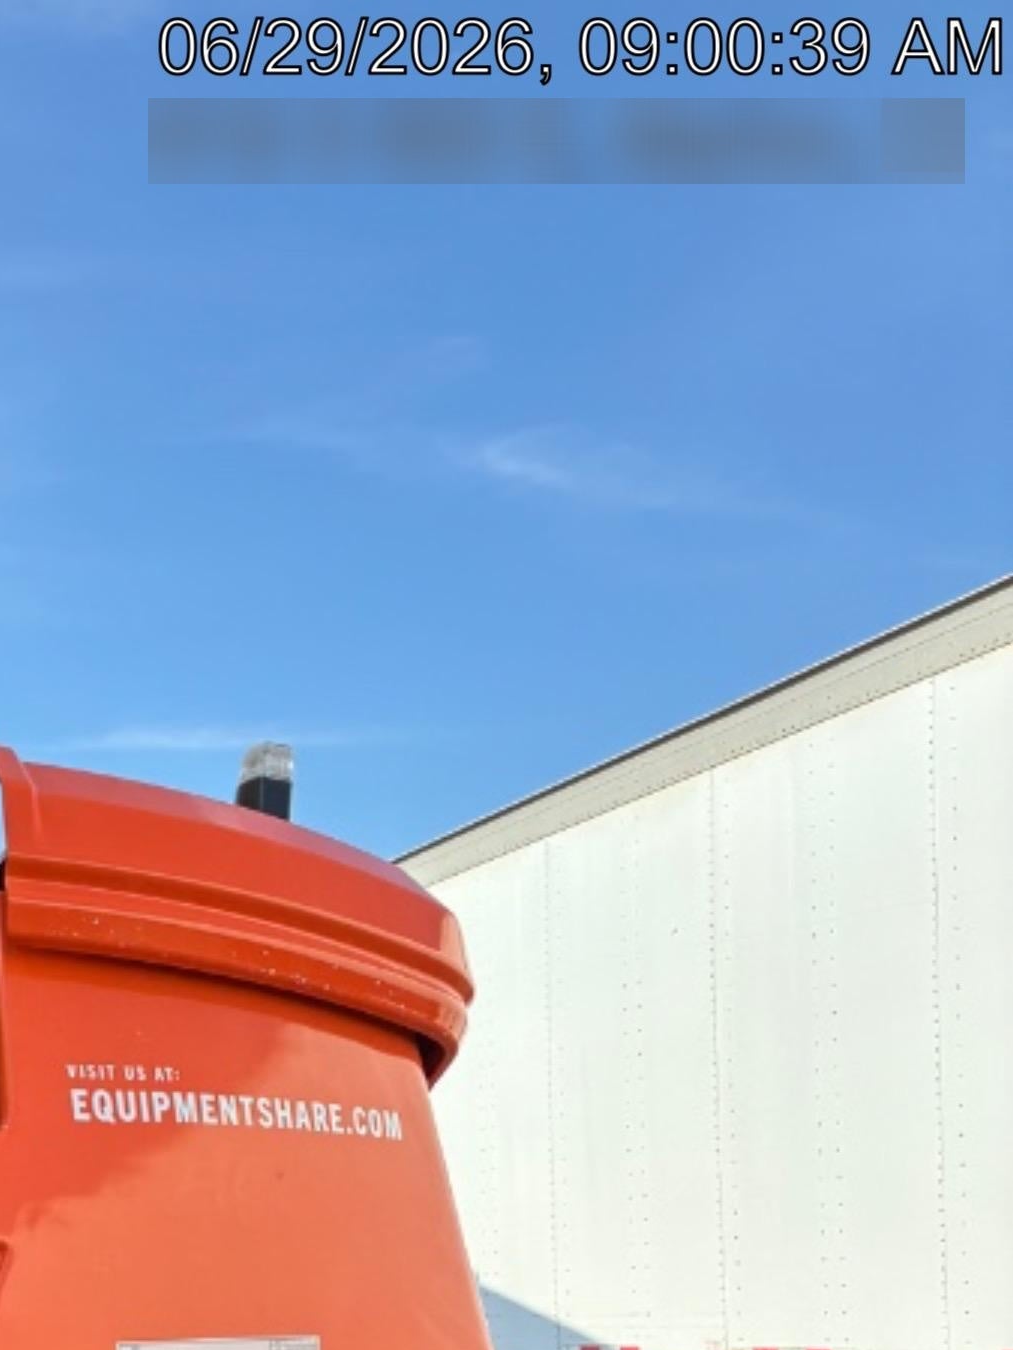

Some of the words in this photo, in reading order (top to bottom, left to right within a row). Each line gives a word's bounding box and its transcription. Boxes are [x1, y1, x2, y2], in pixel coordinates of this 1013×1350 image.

[66, 1064, 115, 1081] VISIT
[124, 1066, 147, 1082] US
[154, 1066, 181, 1082] AT:
[70, 1087, 404, 1141] EQUIPMENTSHARE.COM
